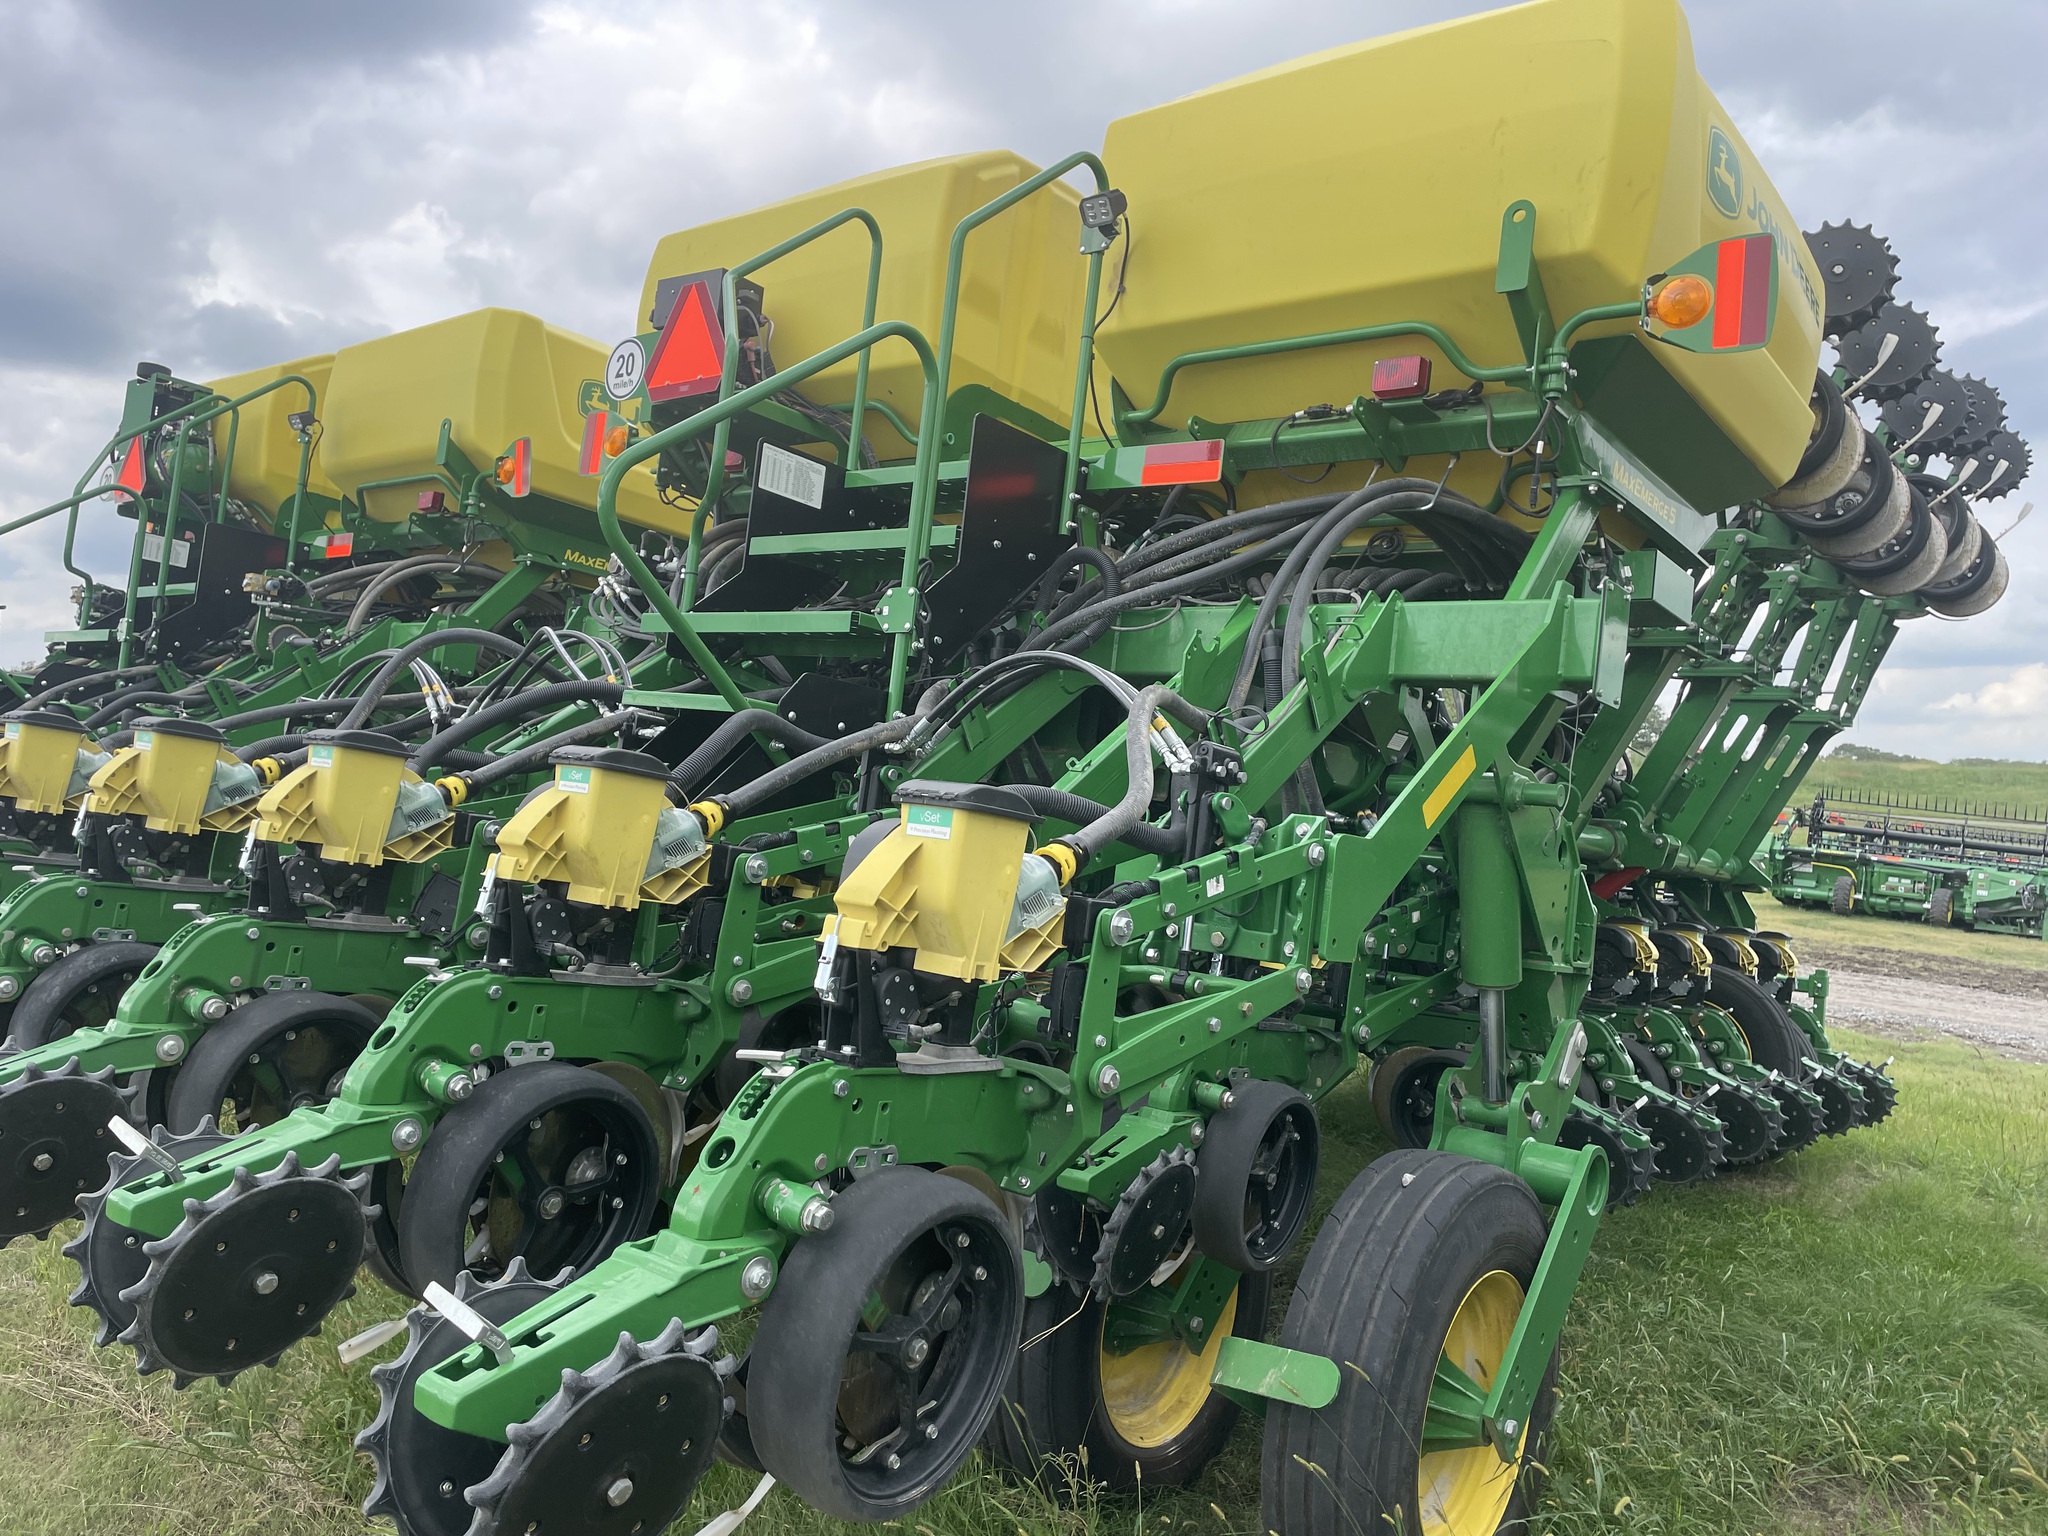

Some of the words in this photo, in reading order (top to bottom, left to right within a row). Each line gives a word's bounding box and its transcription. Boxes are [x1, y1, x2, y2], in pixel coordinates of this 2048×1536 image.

[1790, 240, 1820, 329] DEERE
[615, 352, 635, 379] 20
[612, 378, 634, 390] mile/h
[1668, 506, 1677, 525] 5
[920, 810, 942, 824] vSet
